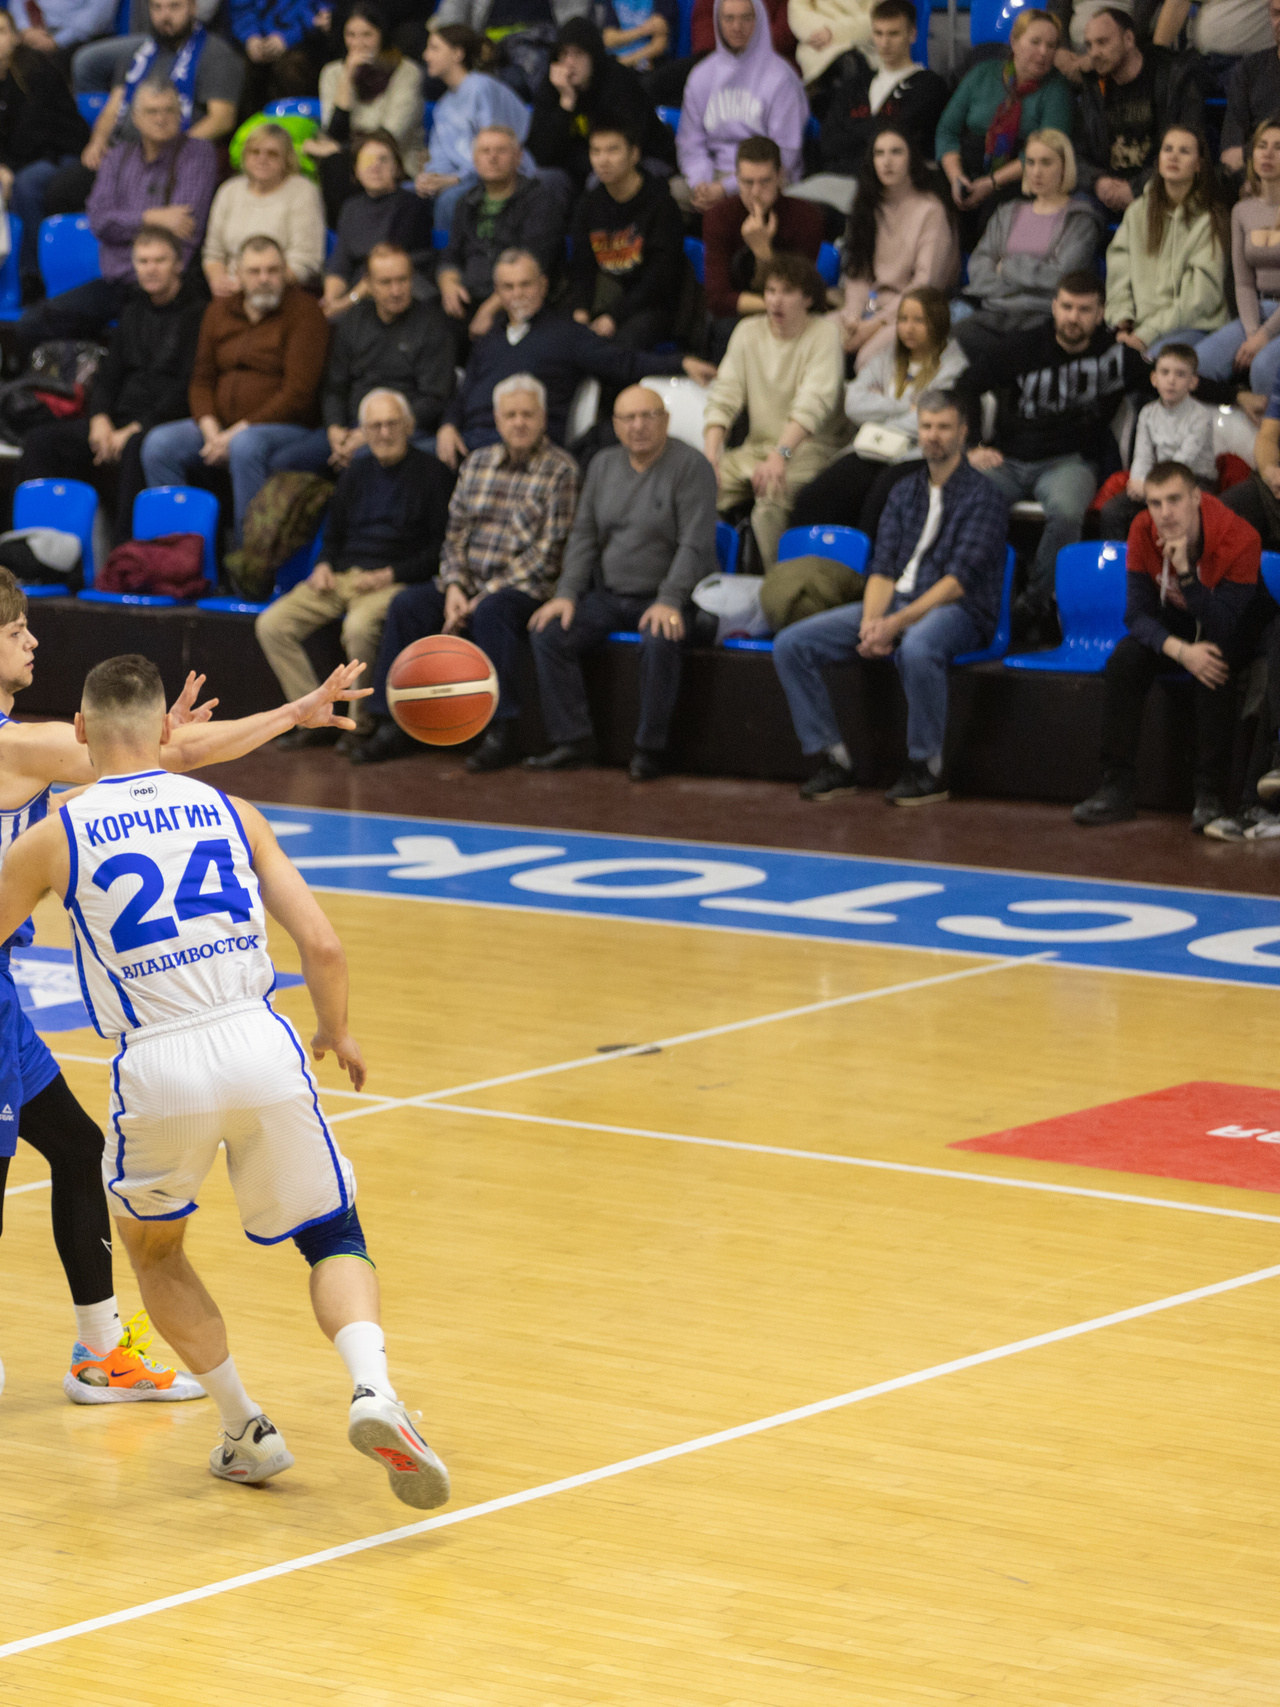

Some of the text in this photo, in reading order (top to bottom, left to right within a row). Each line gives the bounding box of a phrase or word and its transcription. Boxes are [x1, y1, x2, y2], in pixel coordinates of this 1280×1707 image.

[133, 787, 155, 797] РФБ
[85, 804, 222, 847] КОРЧАГИН
[92, 839, 254, 954] 24
[121, 935, 259, 979] ВЛАДИВОСТОК
